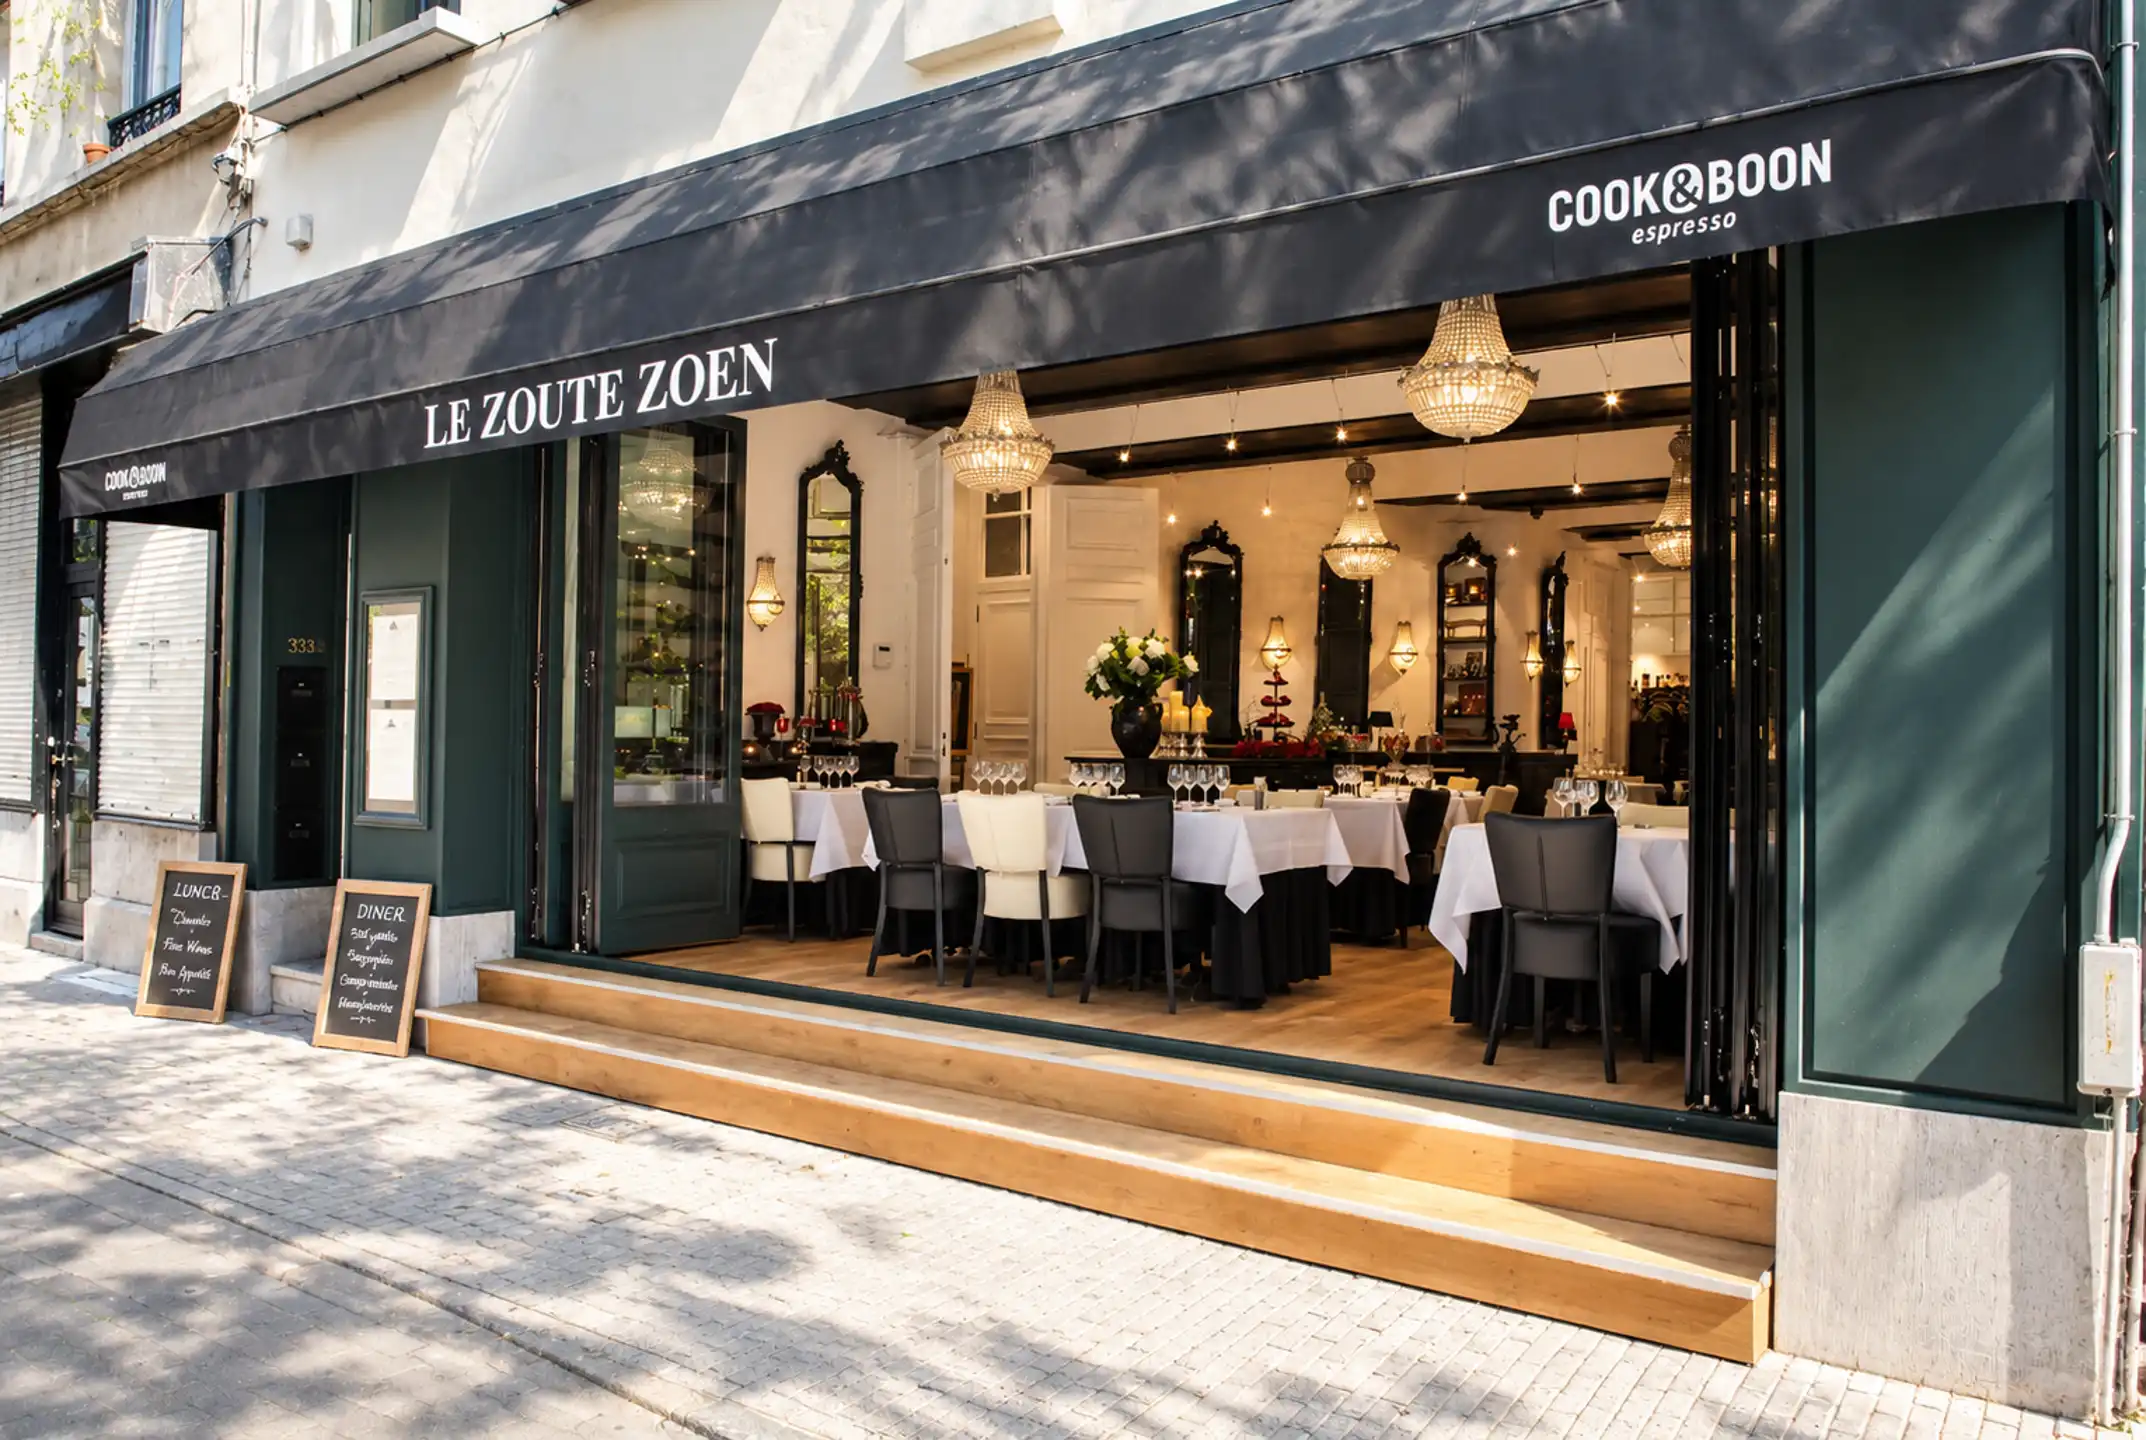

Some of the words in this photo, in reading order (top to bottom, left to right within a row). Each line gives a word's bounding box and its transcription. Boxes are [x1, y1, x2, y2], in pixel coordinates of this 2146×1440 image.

[1548, 138, 1831, 232] COOK&BOON
[1631, 211, 1737, 245] espresso
[423, 398, 471, 449] LE
[479, 368, 625, 440] ZOUTE
[636, 337, 778, 415] ZOEN
[356, 903, 406, 922] DINER
